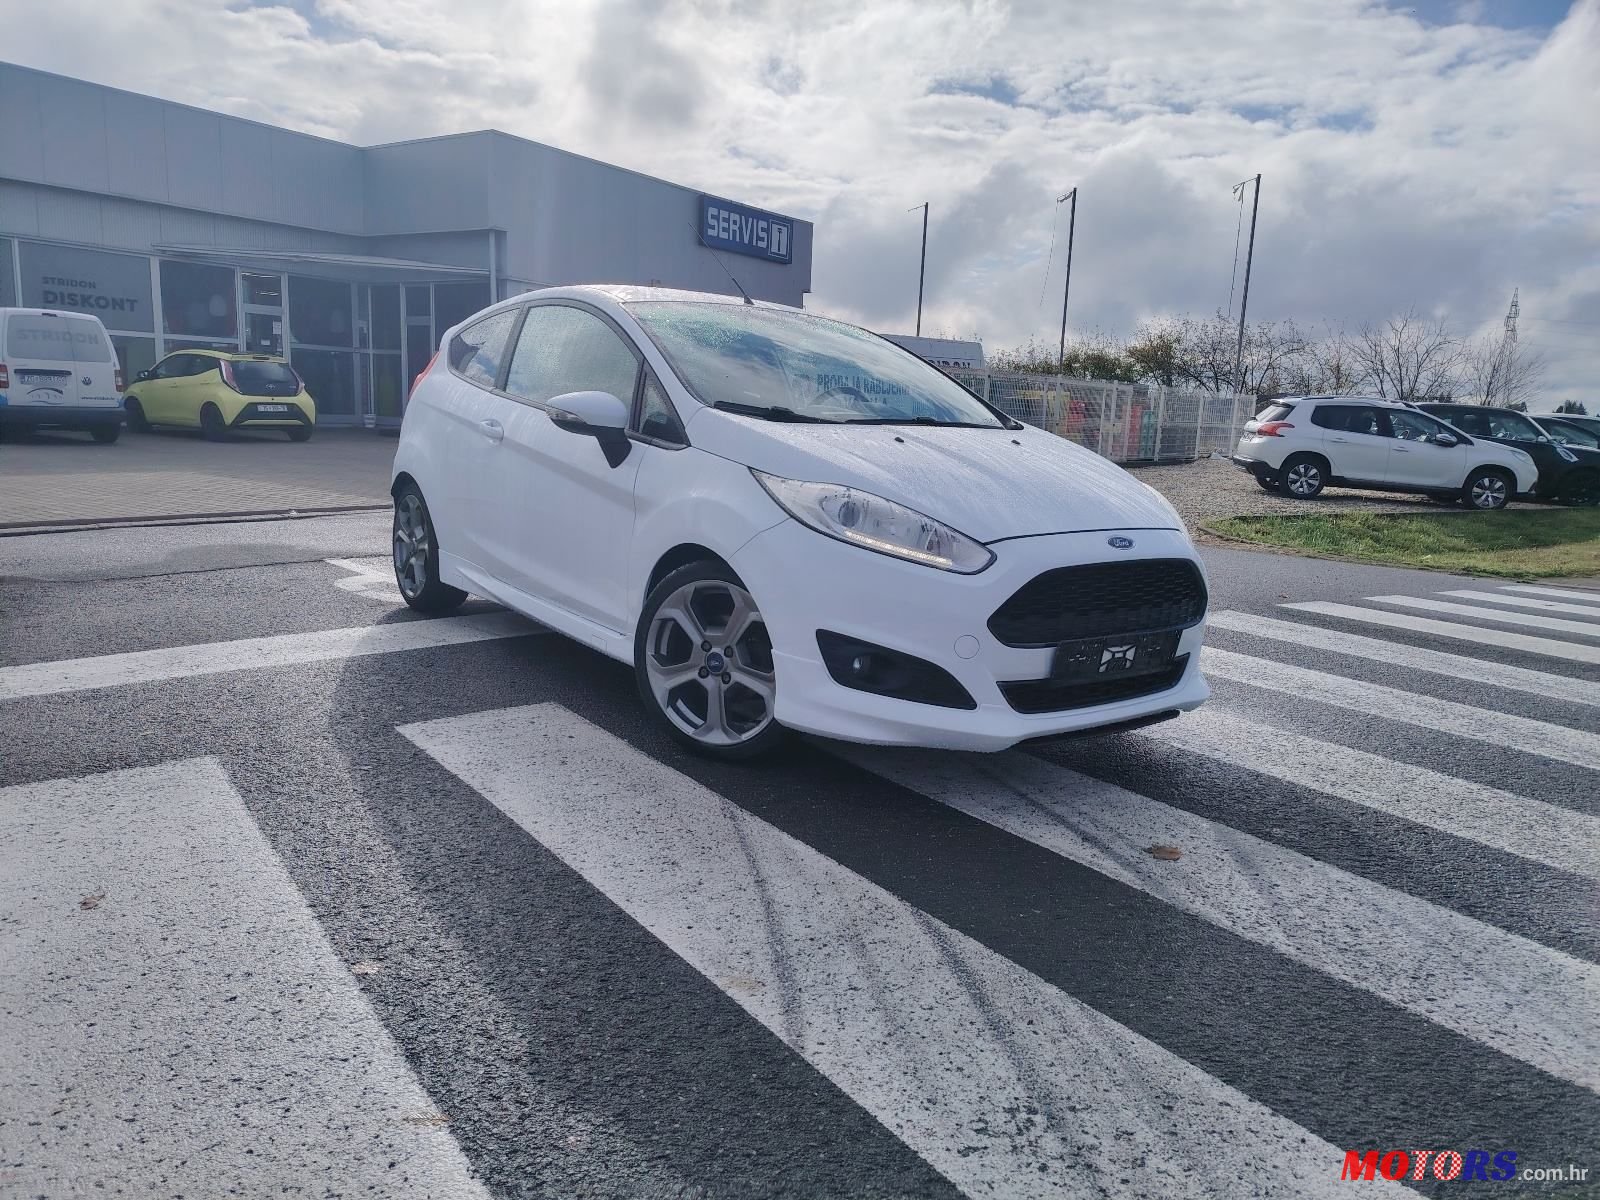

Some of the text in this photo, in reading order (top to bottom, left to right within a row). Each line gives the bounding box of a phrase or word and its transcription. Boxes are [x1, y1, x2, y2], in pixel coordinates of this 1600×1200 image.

[708, 207, 768, 248] SERVIS
[41, 276, 97, 290] STRIDON
[43, 291, 138, 312] DISKONT
[17, 329, 99, 344] STRIDON
